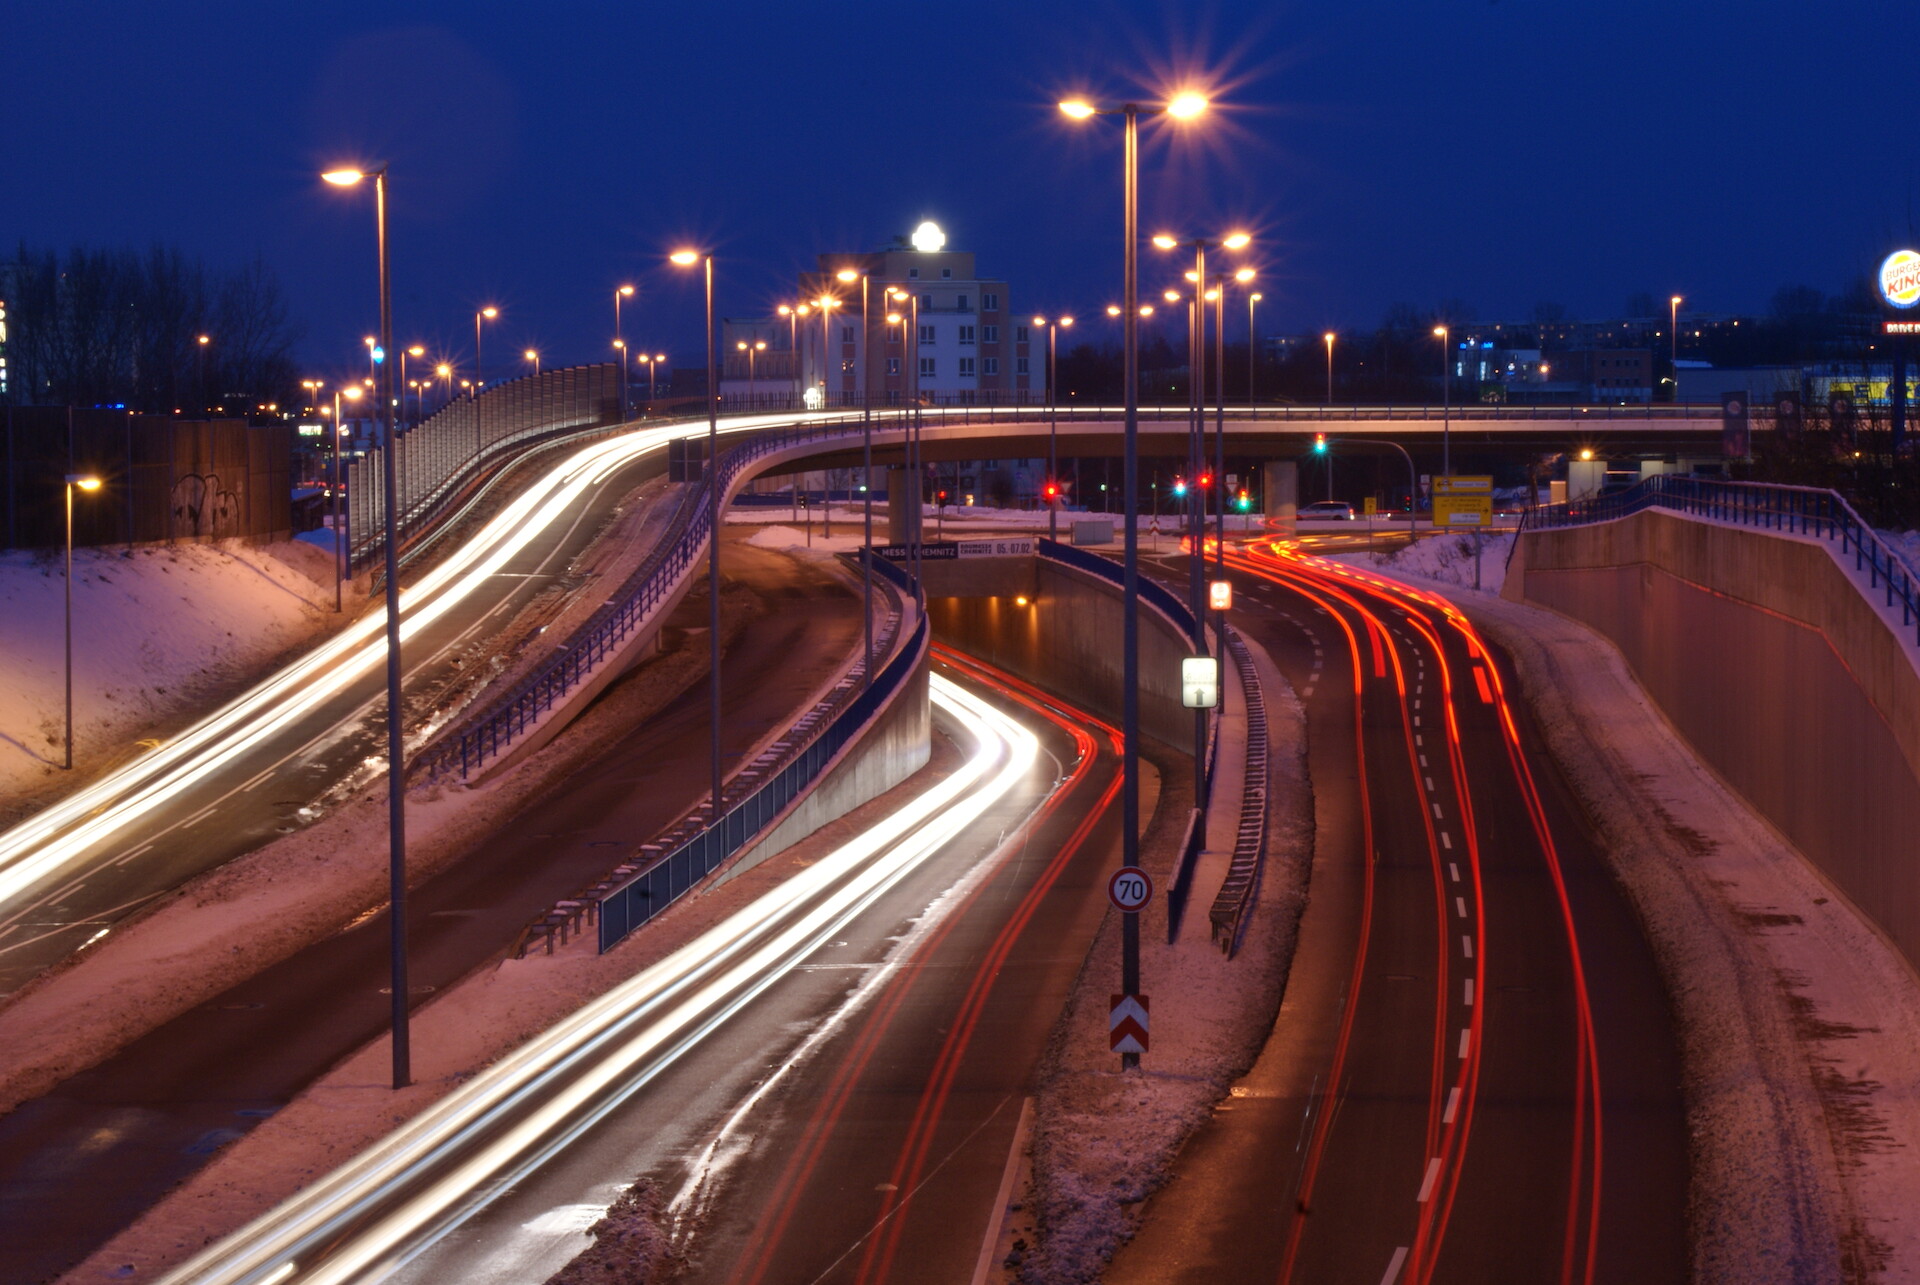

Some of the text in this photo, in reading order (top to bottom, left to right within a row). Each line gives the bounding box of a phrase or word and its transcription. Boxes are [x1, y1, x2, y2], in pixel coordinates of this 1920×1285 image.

[1887, 323, 1913, 333] DRIVE
[882, 548, 906, 557] MESS
[1119, 880, 1143, 900] 70
